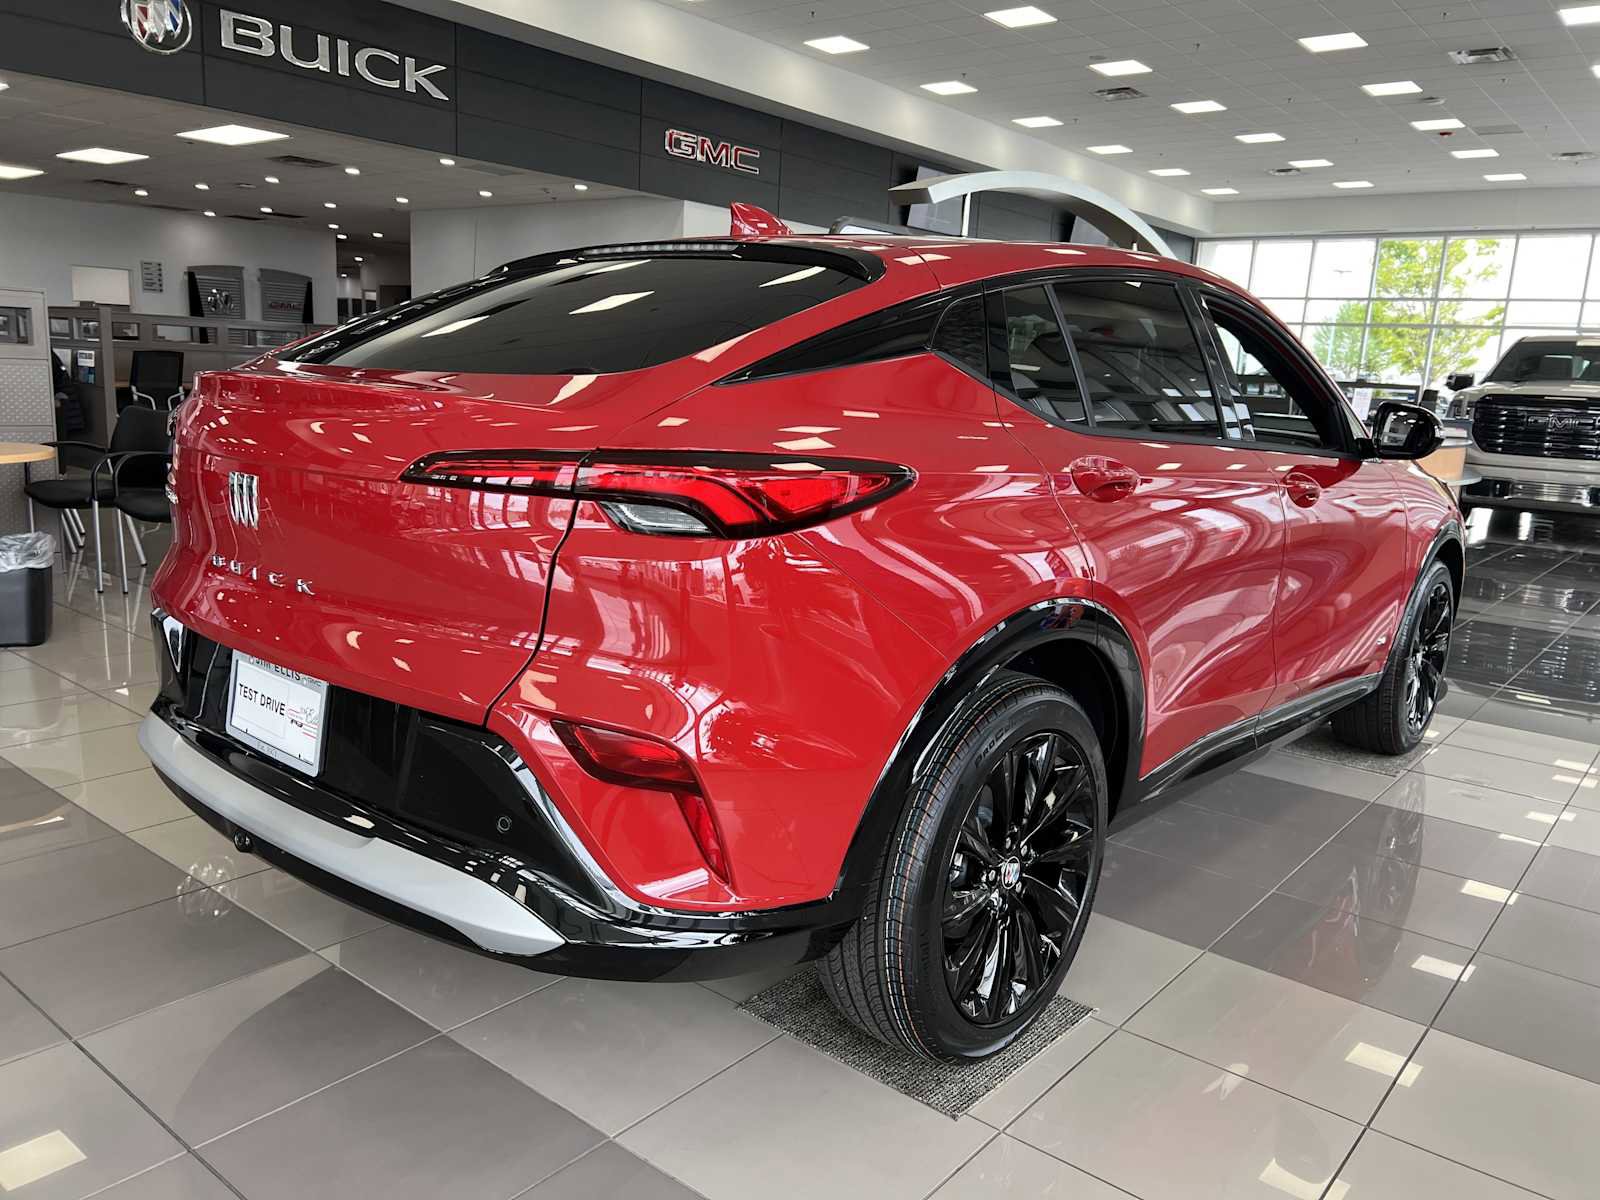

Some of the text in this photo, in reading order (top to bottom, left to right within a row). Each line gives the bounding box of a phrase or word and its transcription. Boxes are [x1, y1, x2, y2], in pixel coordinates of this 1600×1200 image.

[219, 8, 449, 102] BUICK
[664, 128, 760, 174] GMC
[212, 556, 315, 596] BUICK
[274, 664, 301, 681] ELLIS
[239, 683, 259, 704] TEST
[260, 694, 286, 716] DRIVE
